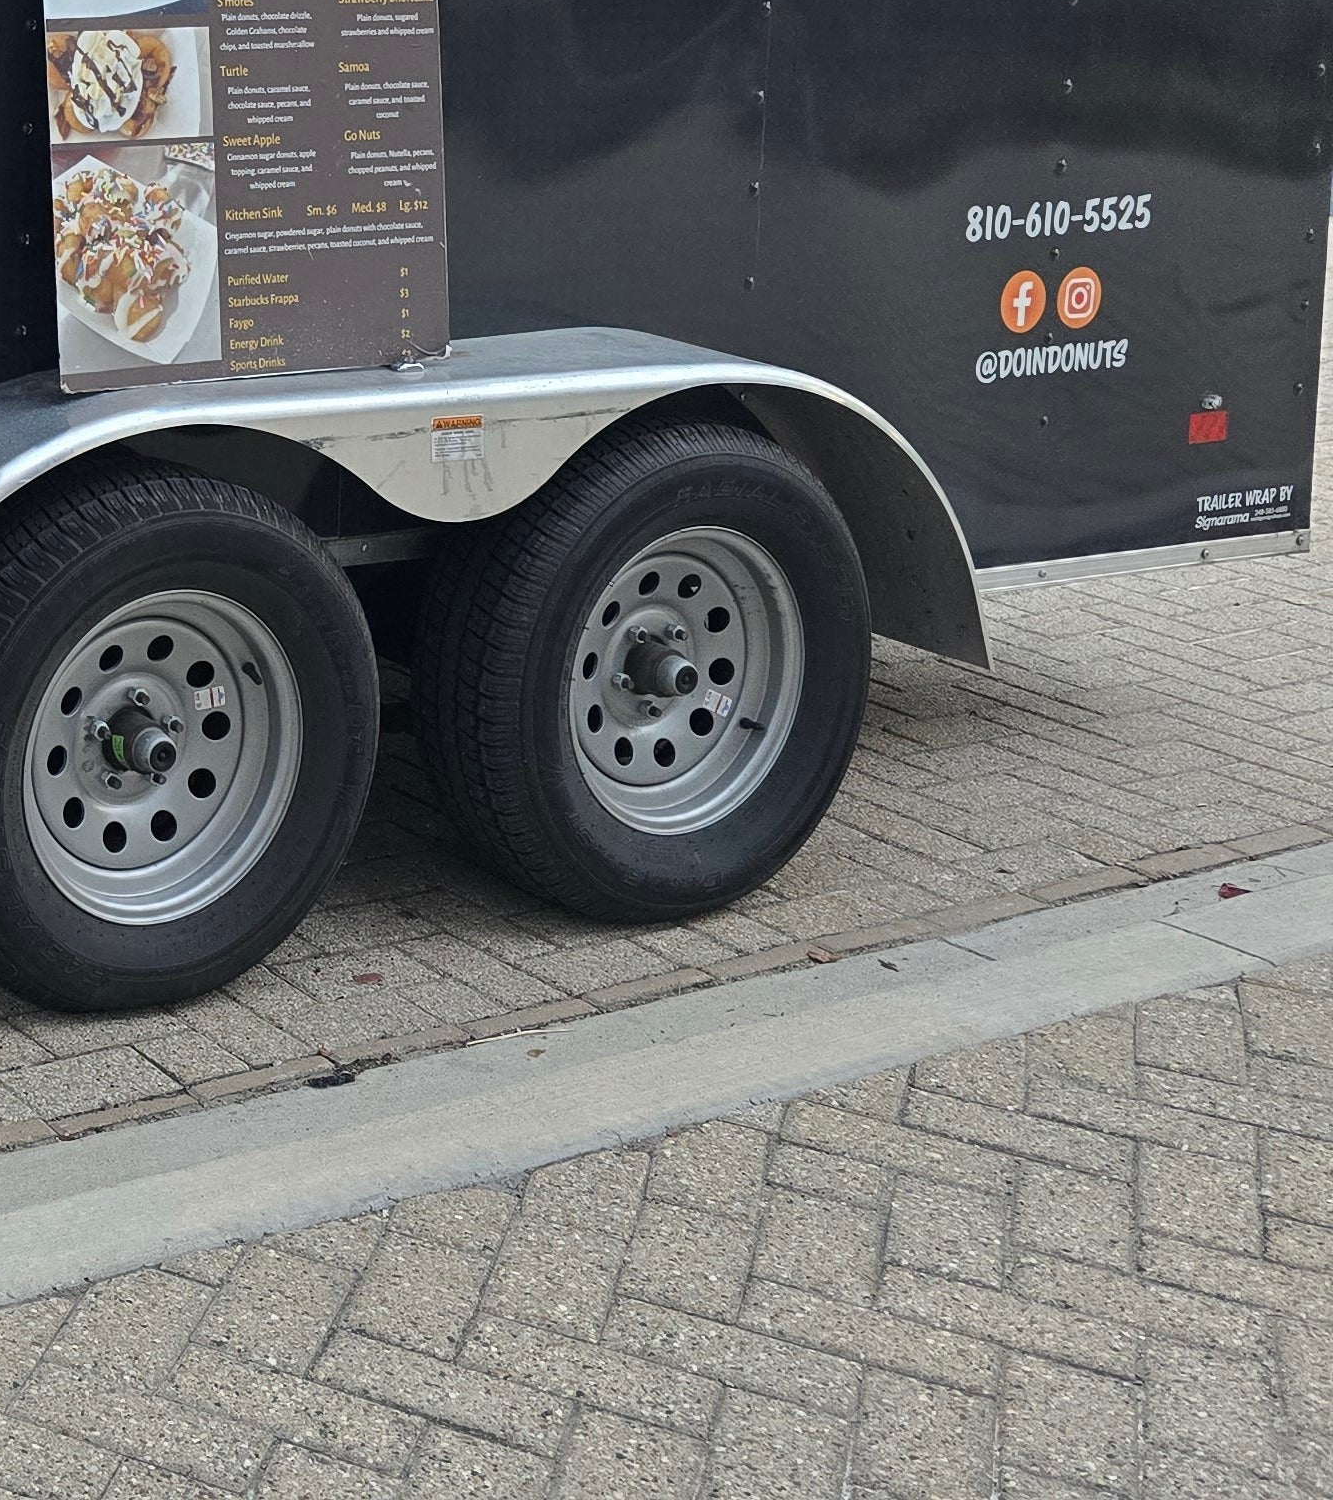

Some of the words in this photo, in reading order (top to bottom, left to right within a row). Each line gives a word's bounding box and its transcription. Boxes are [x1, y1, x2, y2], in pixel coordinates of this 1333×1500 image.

[220, 64, 249, 77] Turtle
[338, 61, 370, 73] Samoa
[222, 135, 251, 147] Sweet
[253, 133, 281, 148] Apple
[344, 130, 357, 141] Go
[358, 129, 381, 140] Nuts
[225, 208, 260, 221] Kitchen
[262, 206, 283, 219] Sink
[306, 205, 324, 216] Sm.
[326, 204, 337, 216] $6
[351, 201, 374, 213] Med.
[376, 201, 387, 213] $8
[399, 200, 412, 213] Lg.
[414, 200, 428, 210] $12
[965, 193, 1152, 243] 810-610-5525
[227, 274, 261, 286] Purified
[262, 273, 289, 284] Water
[228, 293, 269, 308] Starbucks
[270, 293, 300, 306] Frappa
[229, 318, 254, 330] Faygo
[230, 338, 259, 351] Energy
[260, 334, 284, 347] Drink
[230, 358, 257, 372] Sports
[258, 356, 286, 369] Drinks
[975, 338, 1129, 384] @DOINDONUTS
[1196, 492, 1242, 512] TRAILER
[1245, 488, 1277, 506] WRAP
[1279, 485, 1293, 502] BY
[1195, 512, 1250, 530] Signarama
